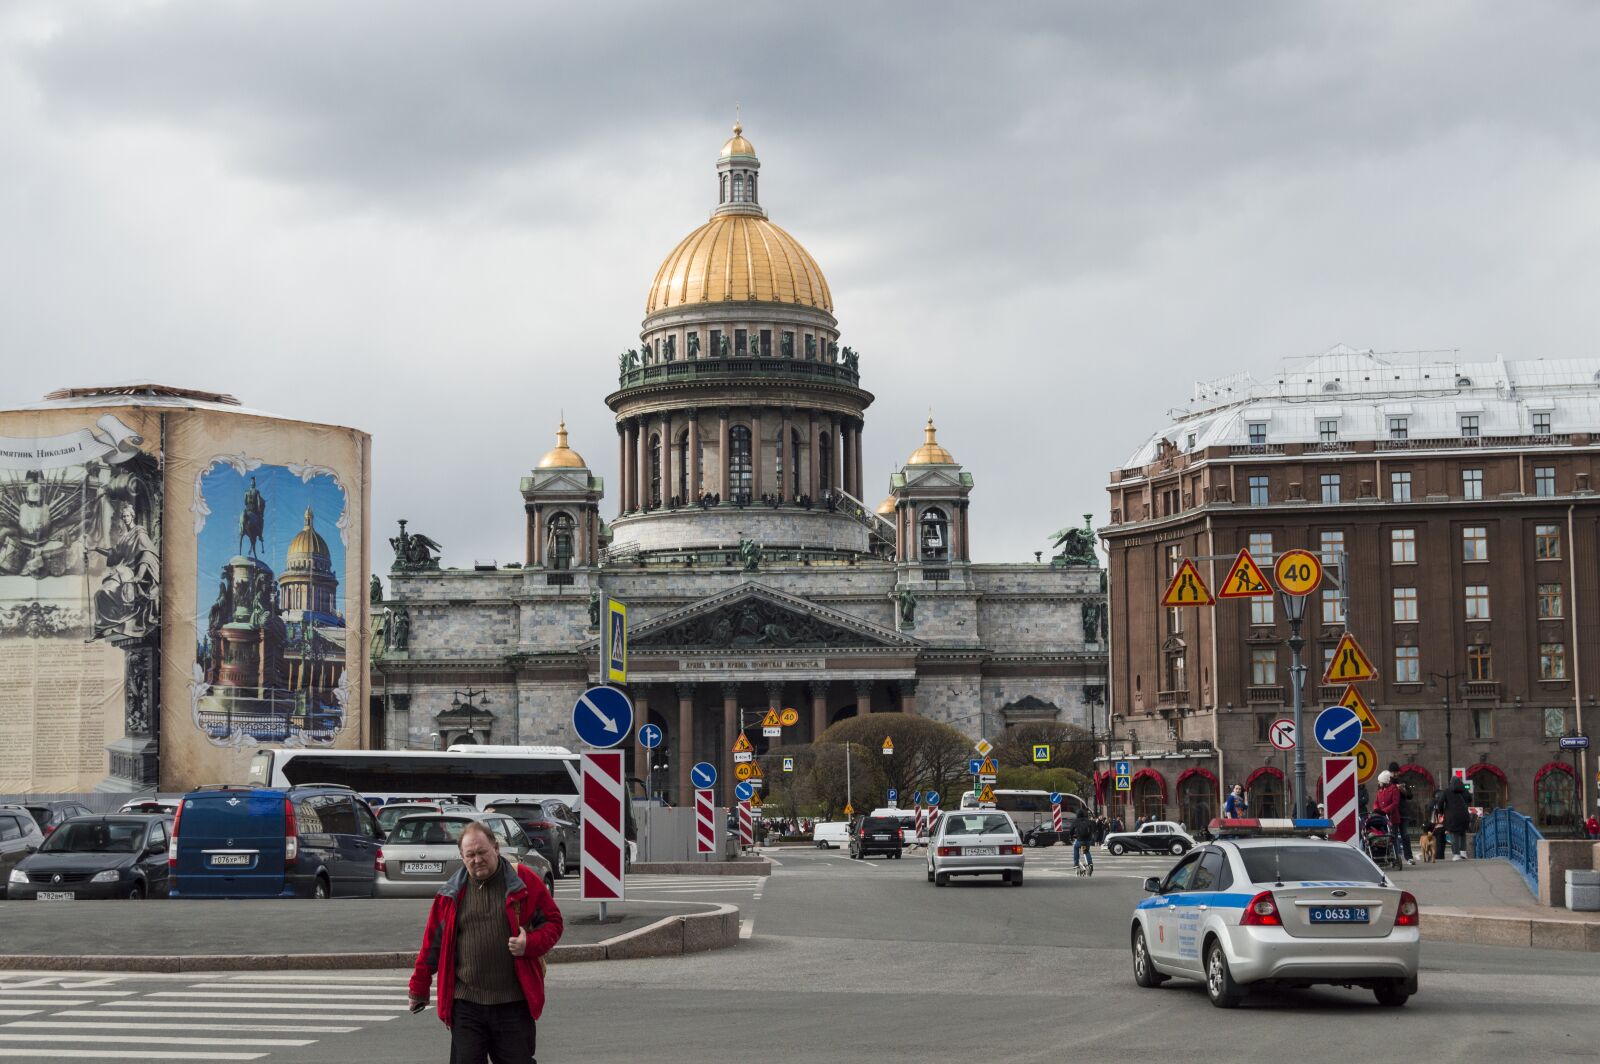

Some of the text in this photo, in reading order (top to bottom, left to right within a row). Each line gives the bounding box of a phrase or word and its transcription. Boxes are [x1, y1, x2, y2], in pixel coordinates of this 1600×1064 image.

[37, 446, 76, 458] Николаю
[1124, 538, 1141, 547] HOTEL
[1284, 564, 1311, 582] 40
[784, 713, 794, 721] 40
[890, 790, 896, 799] P
[1325, 908, 1350, 919] 0633
[1355, 908, 1366, 917] 78
